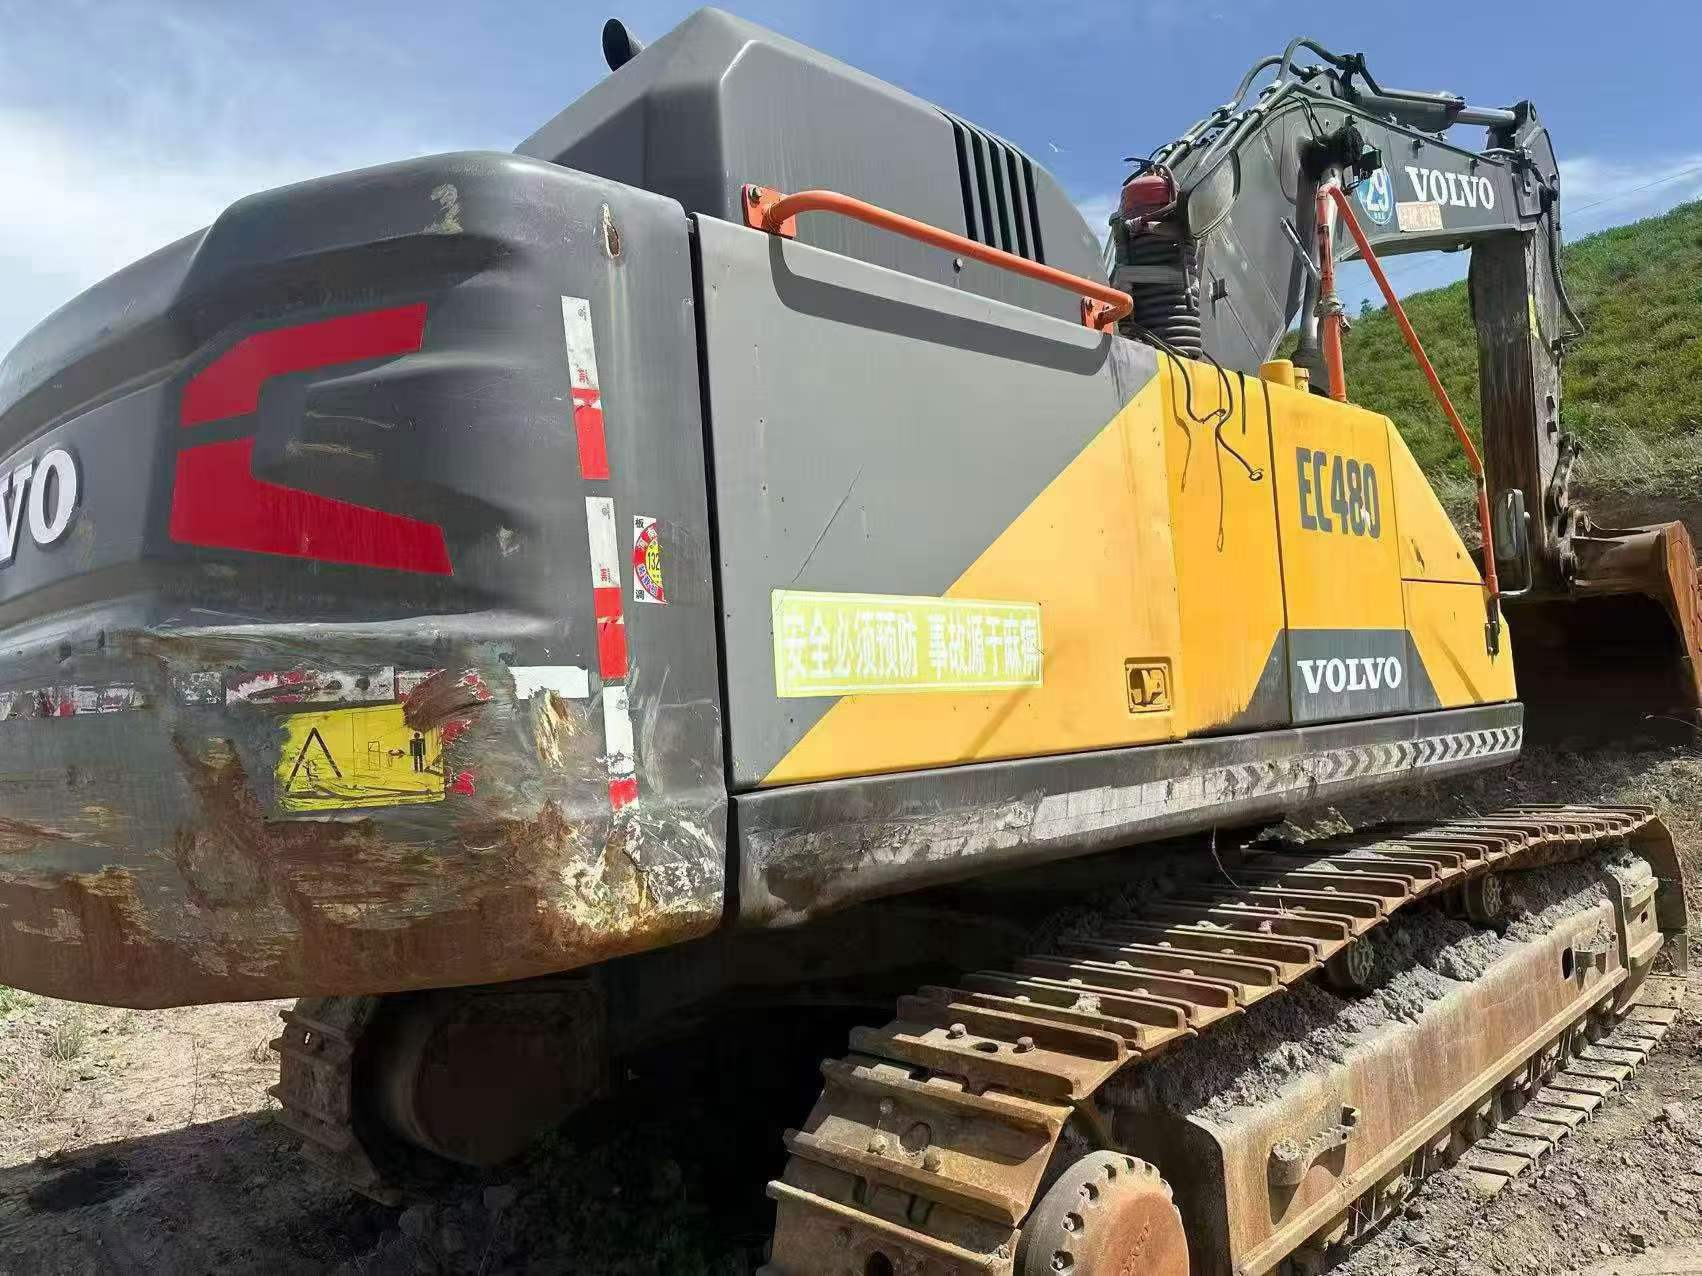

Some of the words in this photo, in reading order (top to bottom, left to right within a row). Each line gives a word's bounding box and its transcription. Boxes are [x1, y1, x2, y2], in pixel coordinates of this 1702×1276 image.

[1405, 165, 1495, 210] VOLVO
[1295, 446, 1381, 539] EC480
[1297, 656, 1402, 694] VOLVO
